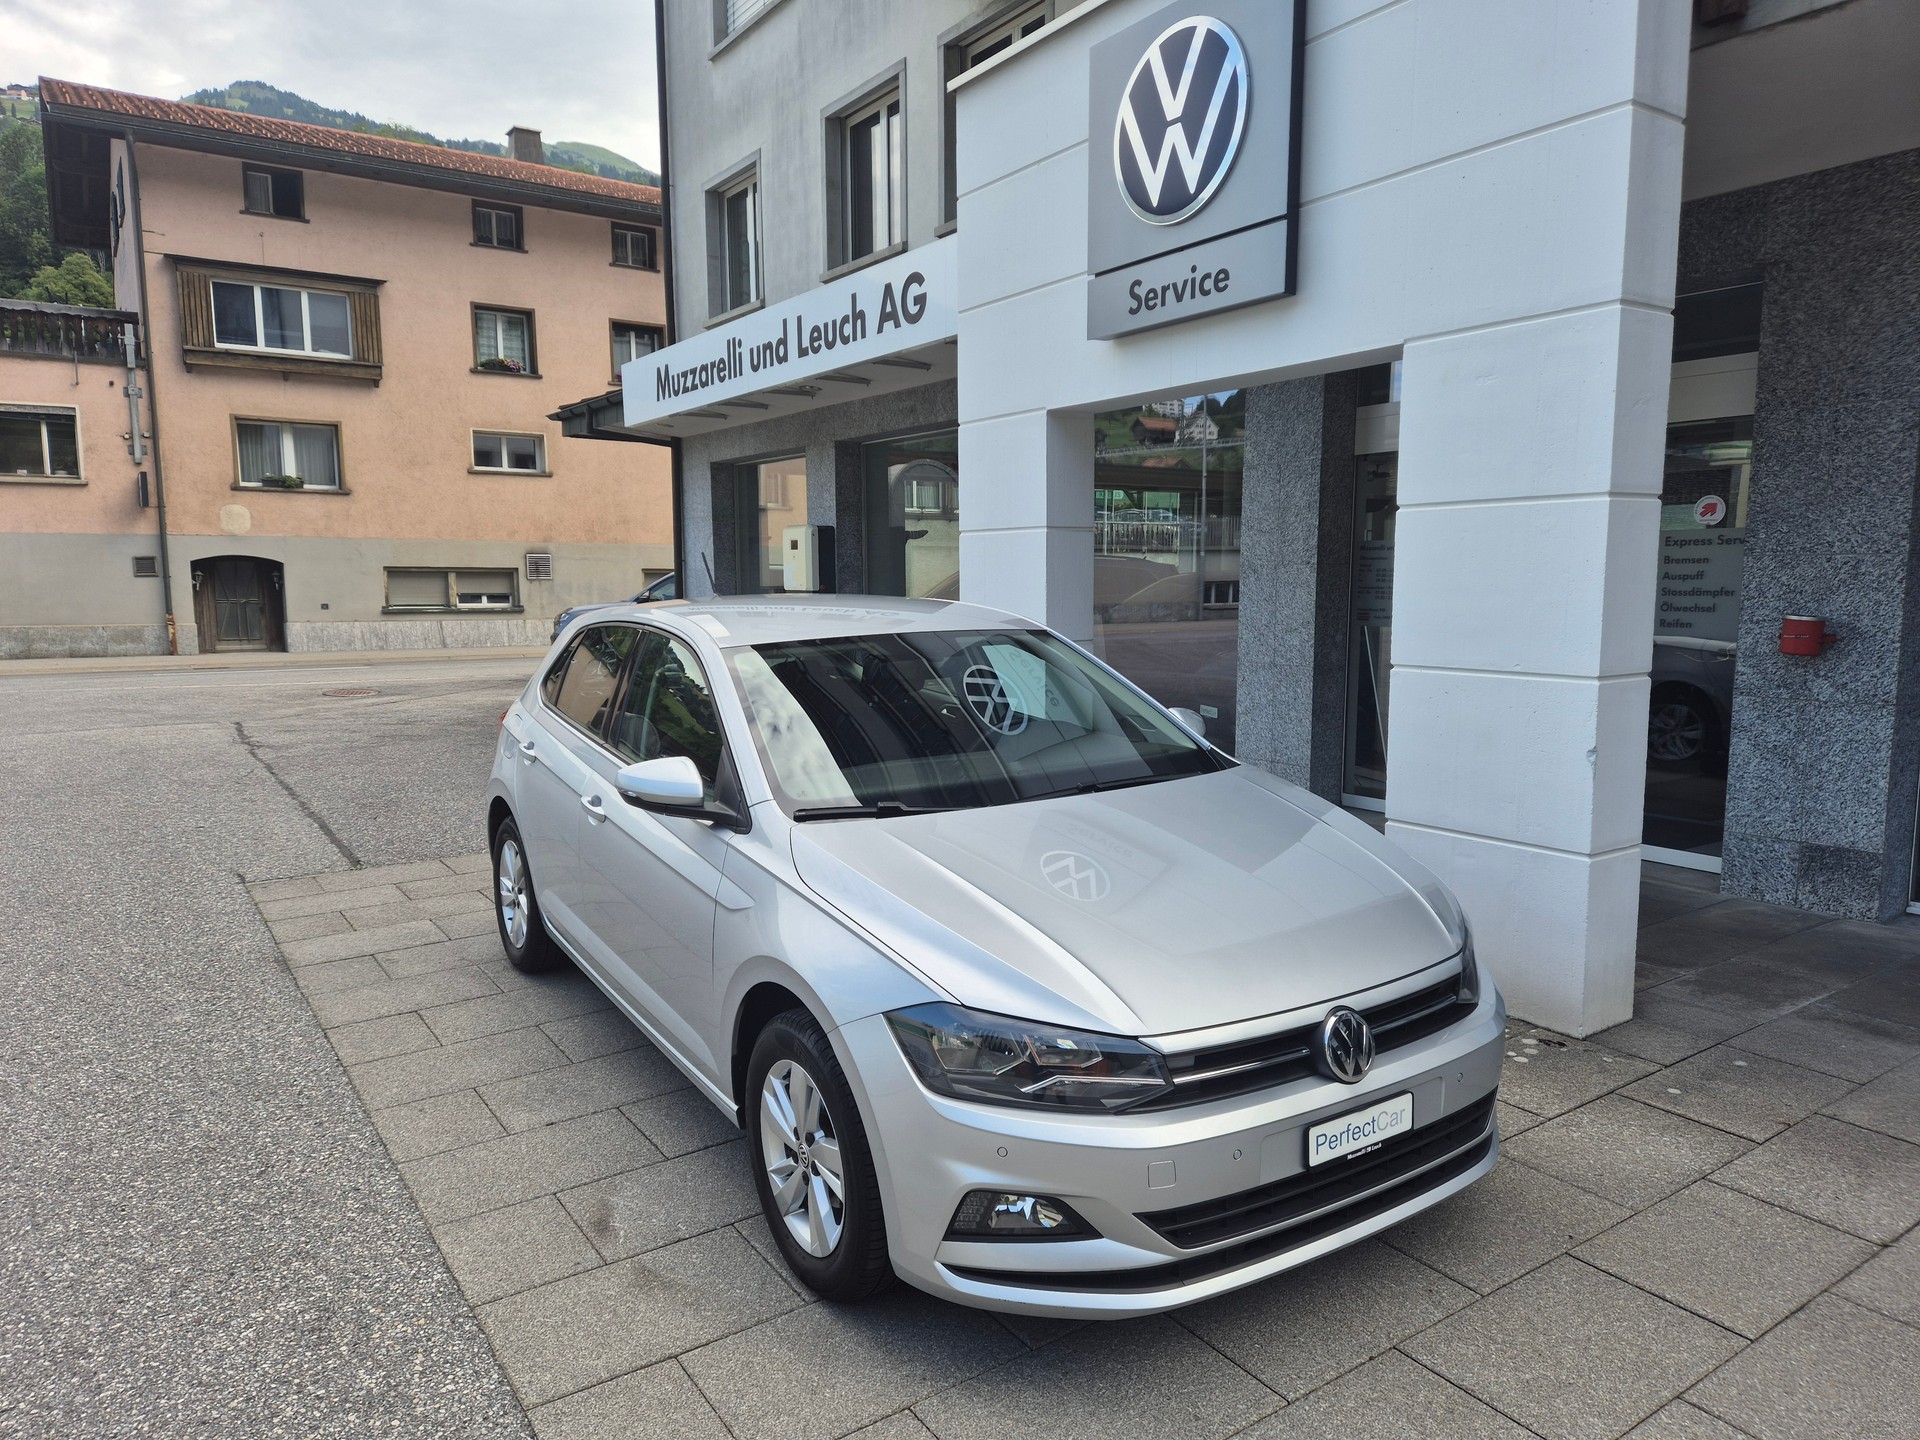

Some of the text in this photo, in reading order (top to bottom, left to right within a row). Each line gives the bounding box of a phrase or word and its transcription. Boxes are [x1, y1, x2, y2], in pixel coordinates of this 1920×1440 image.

[1128, 264, 1230, 316] Service
[656, 271, 927, 402] Muzzarelli und Leuch AG
[1664, 536, 1712, 549] Express
[1663, 555, 1710, 565] Bremsen
[1662, 570, 1705, 582] Auspuff
[1661, 586, 1735, 599] Stossdämpfer
[1660, 602, 1716, 613] Ölwechsel
[1659, 618, 1692, 629] Reifen
[1315, 1108, 1406, 1155] PerfectCar
